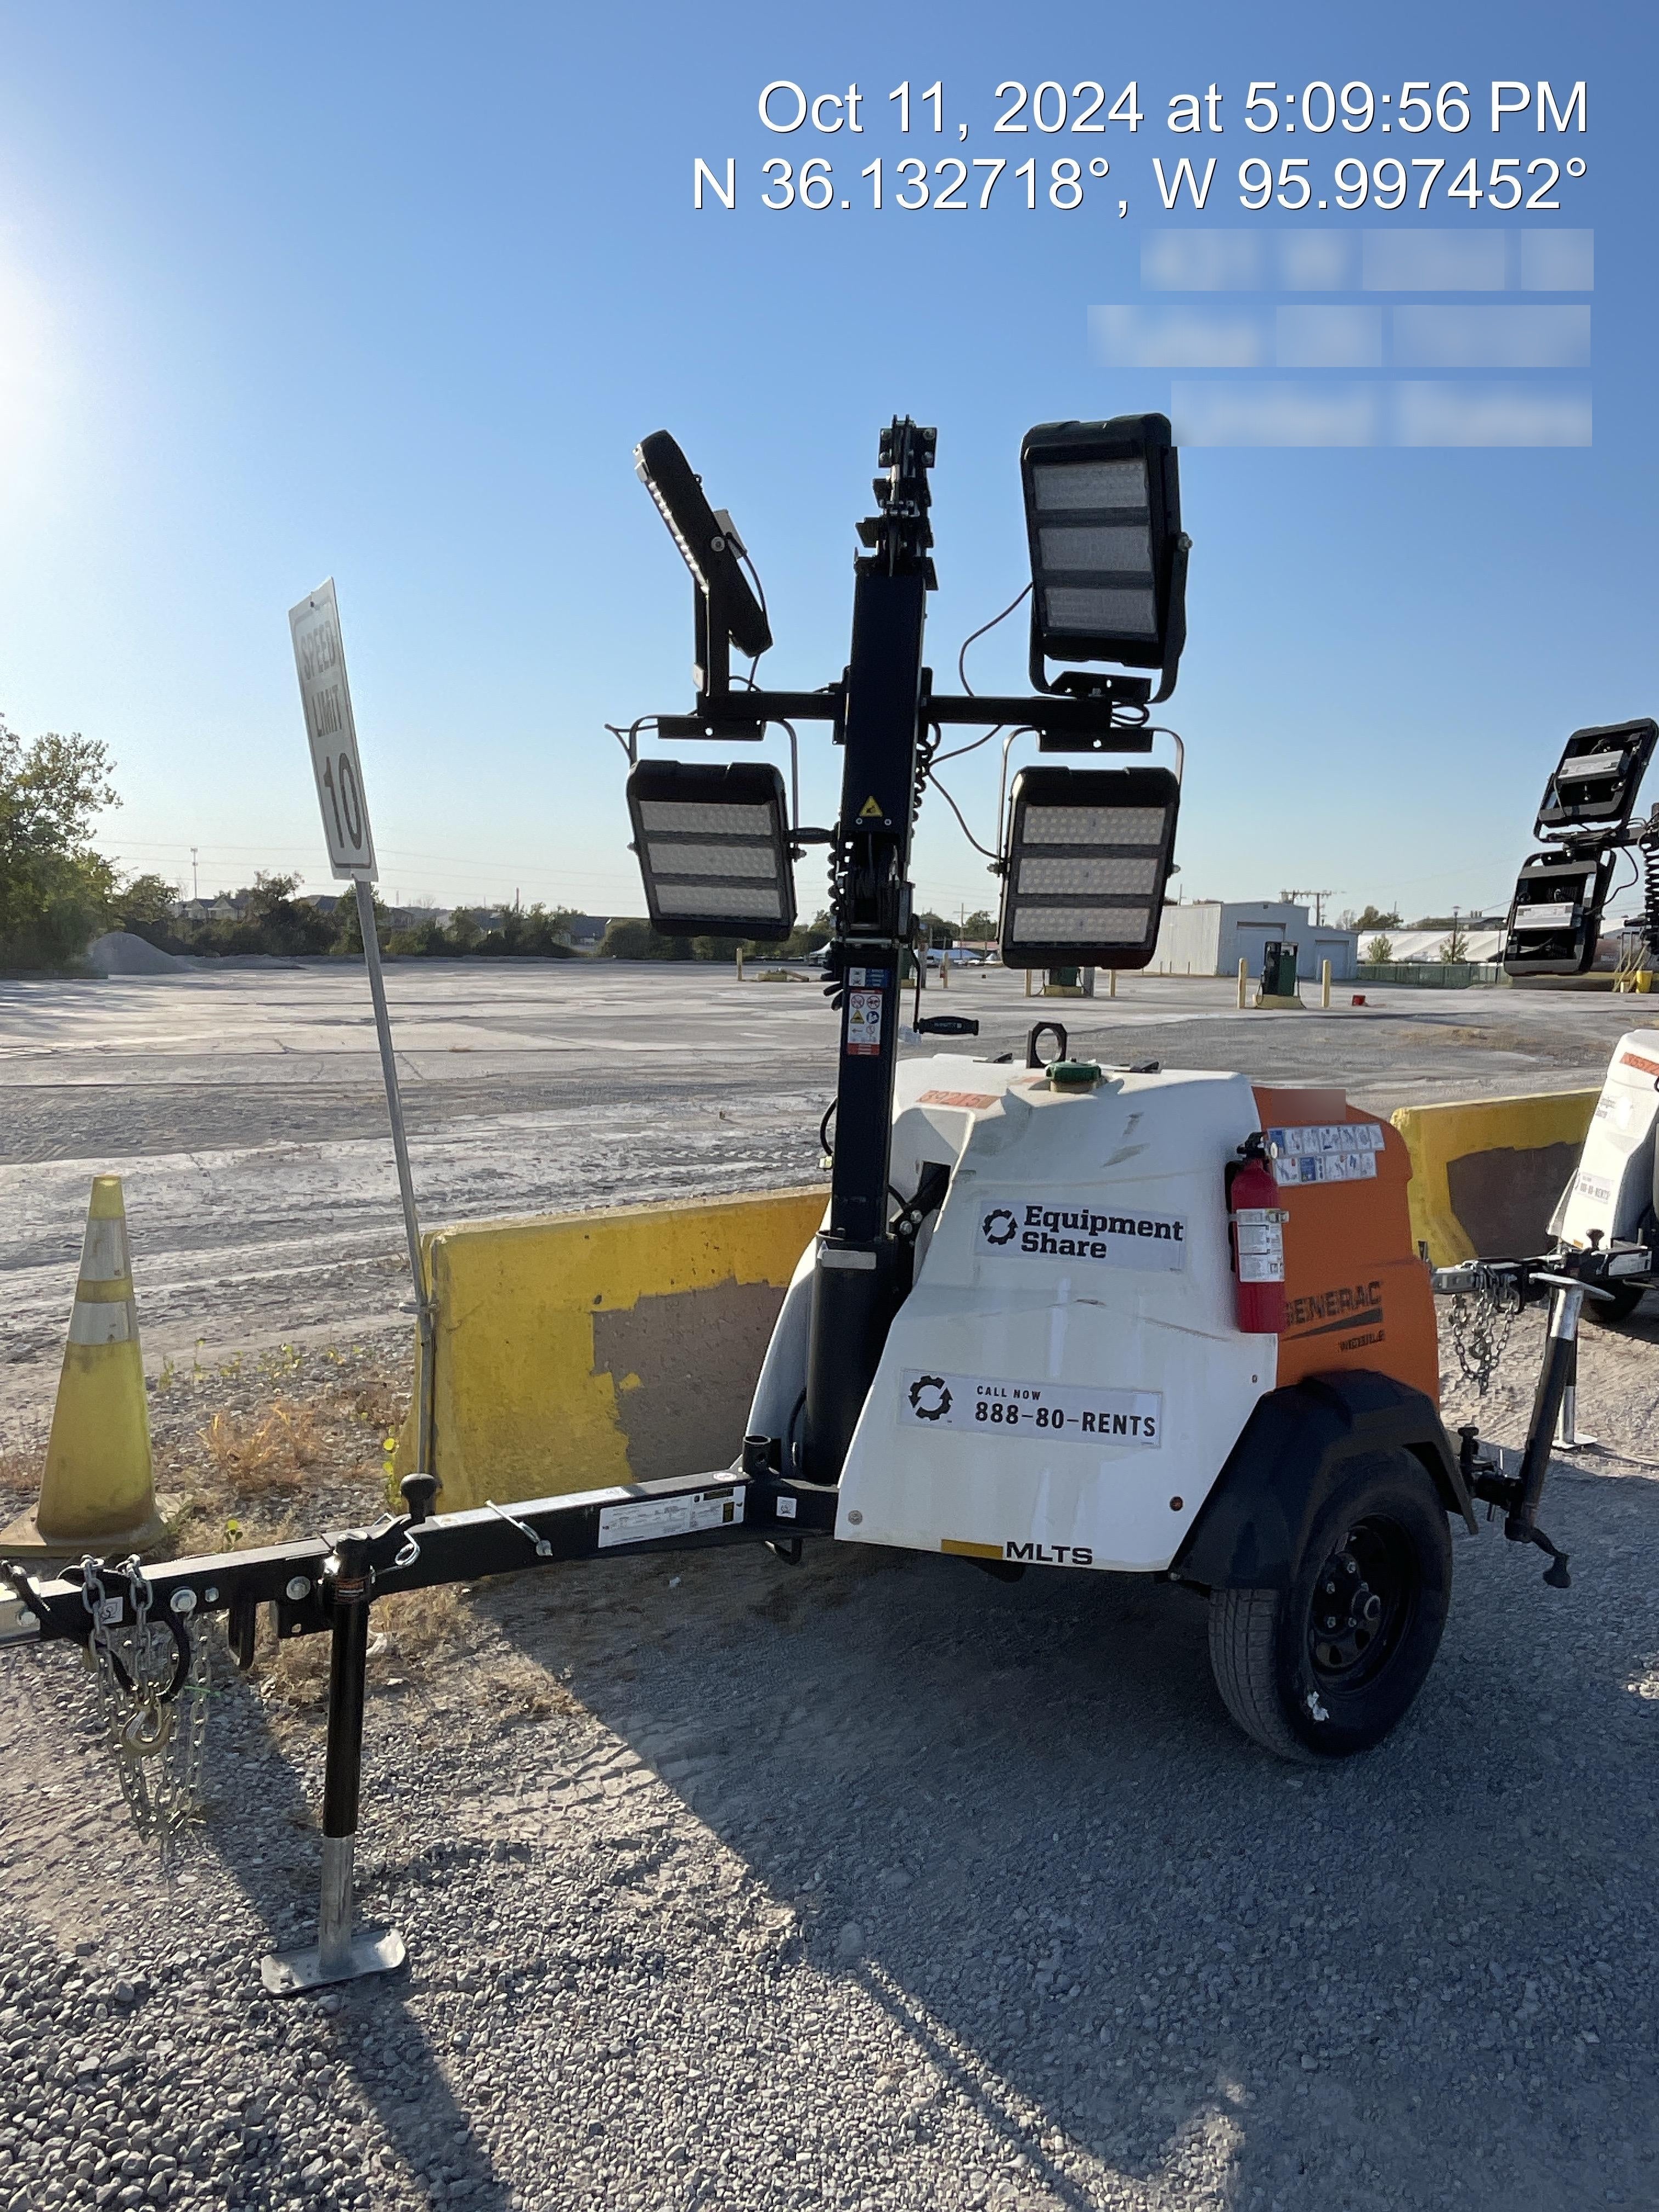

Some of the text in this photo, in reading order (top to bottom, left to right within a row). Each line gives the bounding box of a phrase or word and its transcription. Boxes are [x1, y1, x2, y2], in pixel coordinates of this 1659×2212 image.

[301, 620, 336, 680] SPEED
[312, 684, 343, 737] LIMIT
[323, 752, 363, 850] 10
[1024, 1205, 1184, 1242] Equipment
[1021, 1231, 1107, 1259] Share
[977, 1385, 1041, 1401] CALL NOW
[975, 1401, 1156, 1437] 888-80-RENTS
[1006, 1541, 1093, 1565] MLTS
